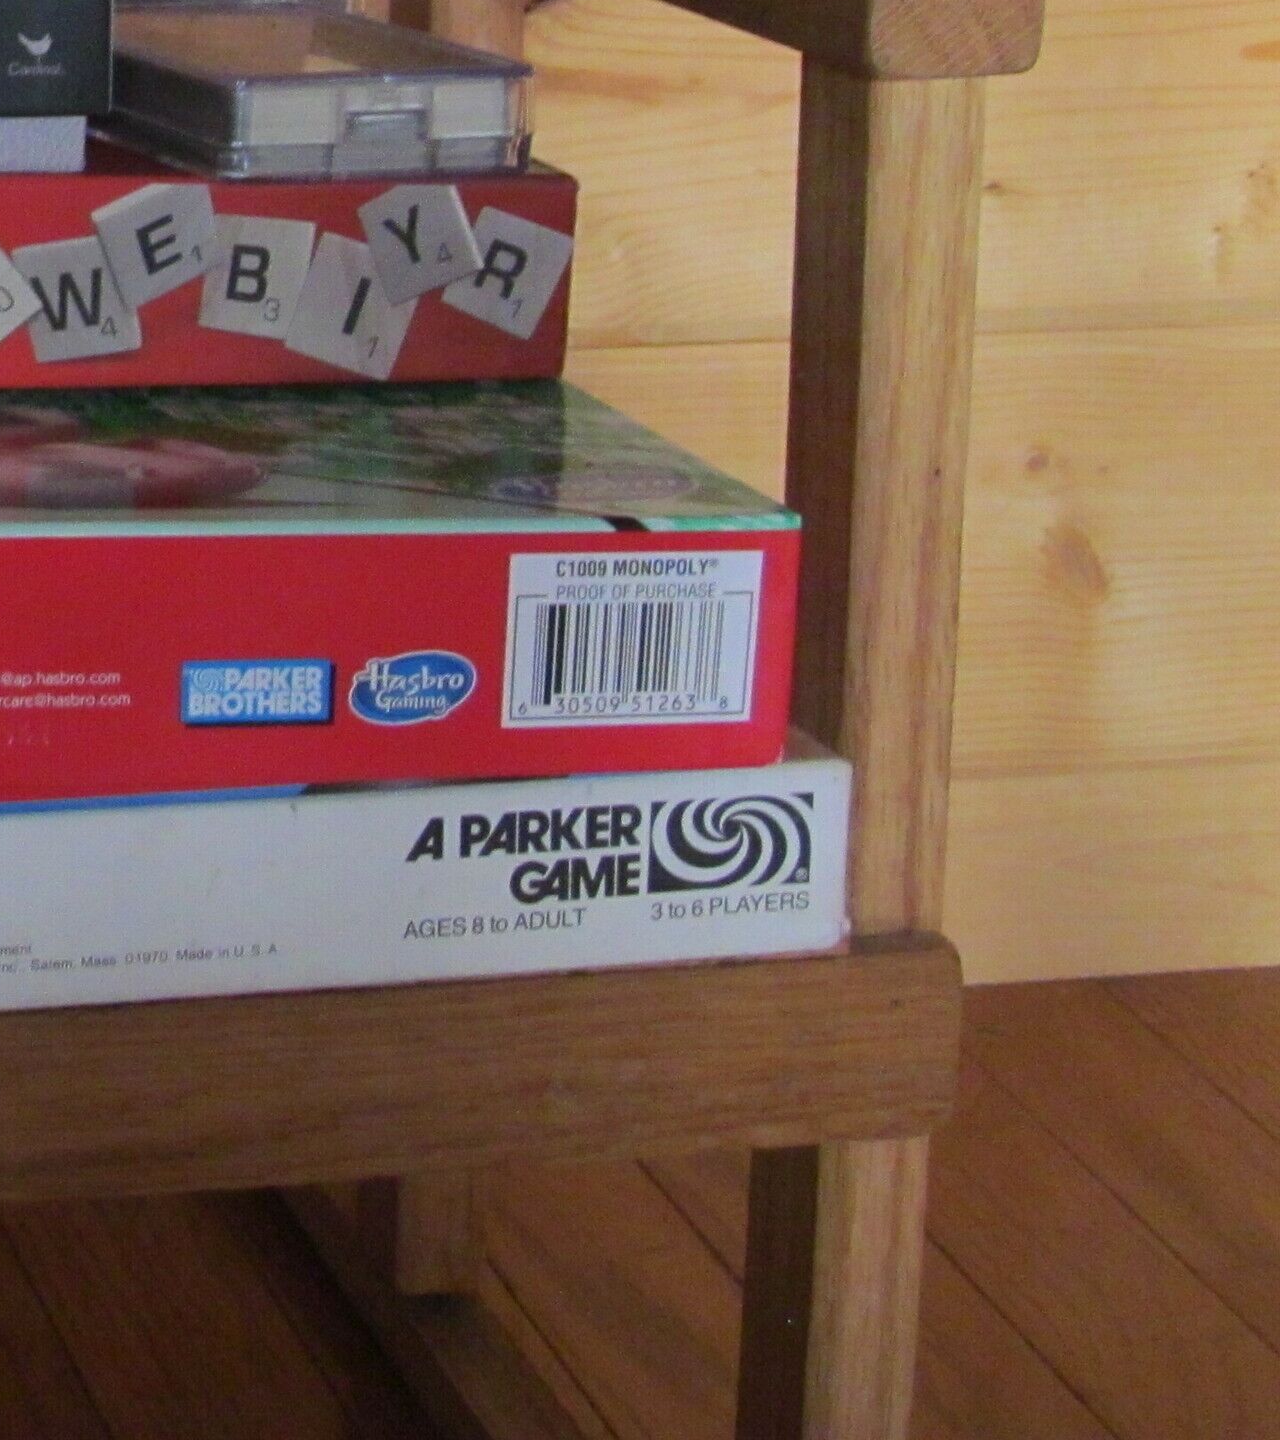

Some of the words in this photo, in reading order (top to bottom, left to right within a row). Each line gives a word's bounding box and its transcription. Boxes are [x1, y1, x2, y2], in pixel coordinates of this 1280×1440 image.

[136, 215, 185, 275] E
[385, 204, 423, 263] Y
[226, 245, 267, 303] B
[262, 300, 280, 323] 3
[474, 240, 528, 300] R
[30, 268, 103, 333] W
[100, 315, 118, 339] 4
[342, 276, 371, 335] I
[556, 560, 607, 578] C1009
[555, 584, 605, 601] PROOF
[611, 583, 631, 600] OF
[635, 581, 717, 600] PURCHASE
[224, 667, 323, 691] PARKER
[356, 662, 465, 697] Hasbro
[189, 691, 322, 715] BROTHERS
[375, 691, 447, 715] Gaming
[518, 702, 527, 716] 6
[554, 696, 620, 715] 30509
[631, 693, 696, 712] 51263
[720, 695, 728, 709] 8
[406, 818, 444, 862] A
[460, 804, 643, 858] PARKER
[510, 854, 641, 904] GAME
[650, 901, 663, 921] 3
[668, 900, 686, 920] to
[690, 898, 704, 918] 6
[710, 891, 810, 915] PLAYERS
[403, 911, 467, 939] AGES
[471, 912, 484, 935] 8
[491, 914, 508, 934] to
[513, 908, 587, 933] ADULT
[175, 946, 213, 961] Made
[218, 946, 230, 959] in
